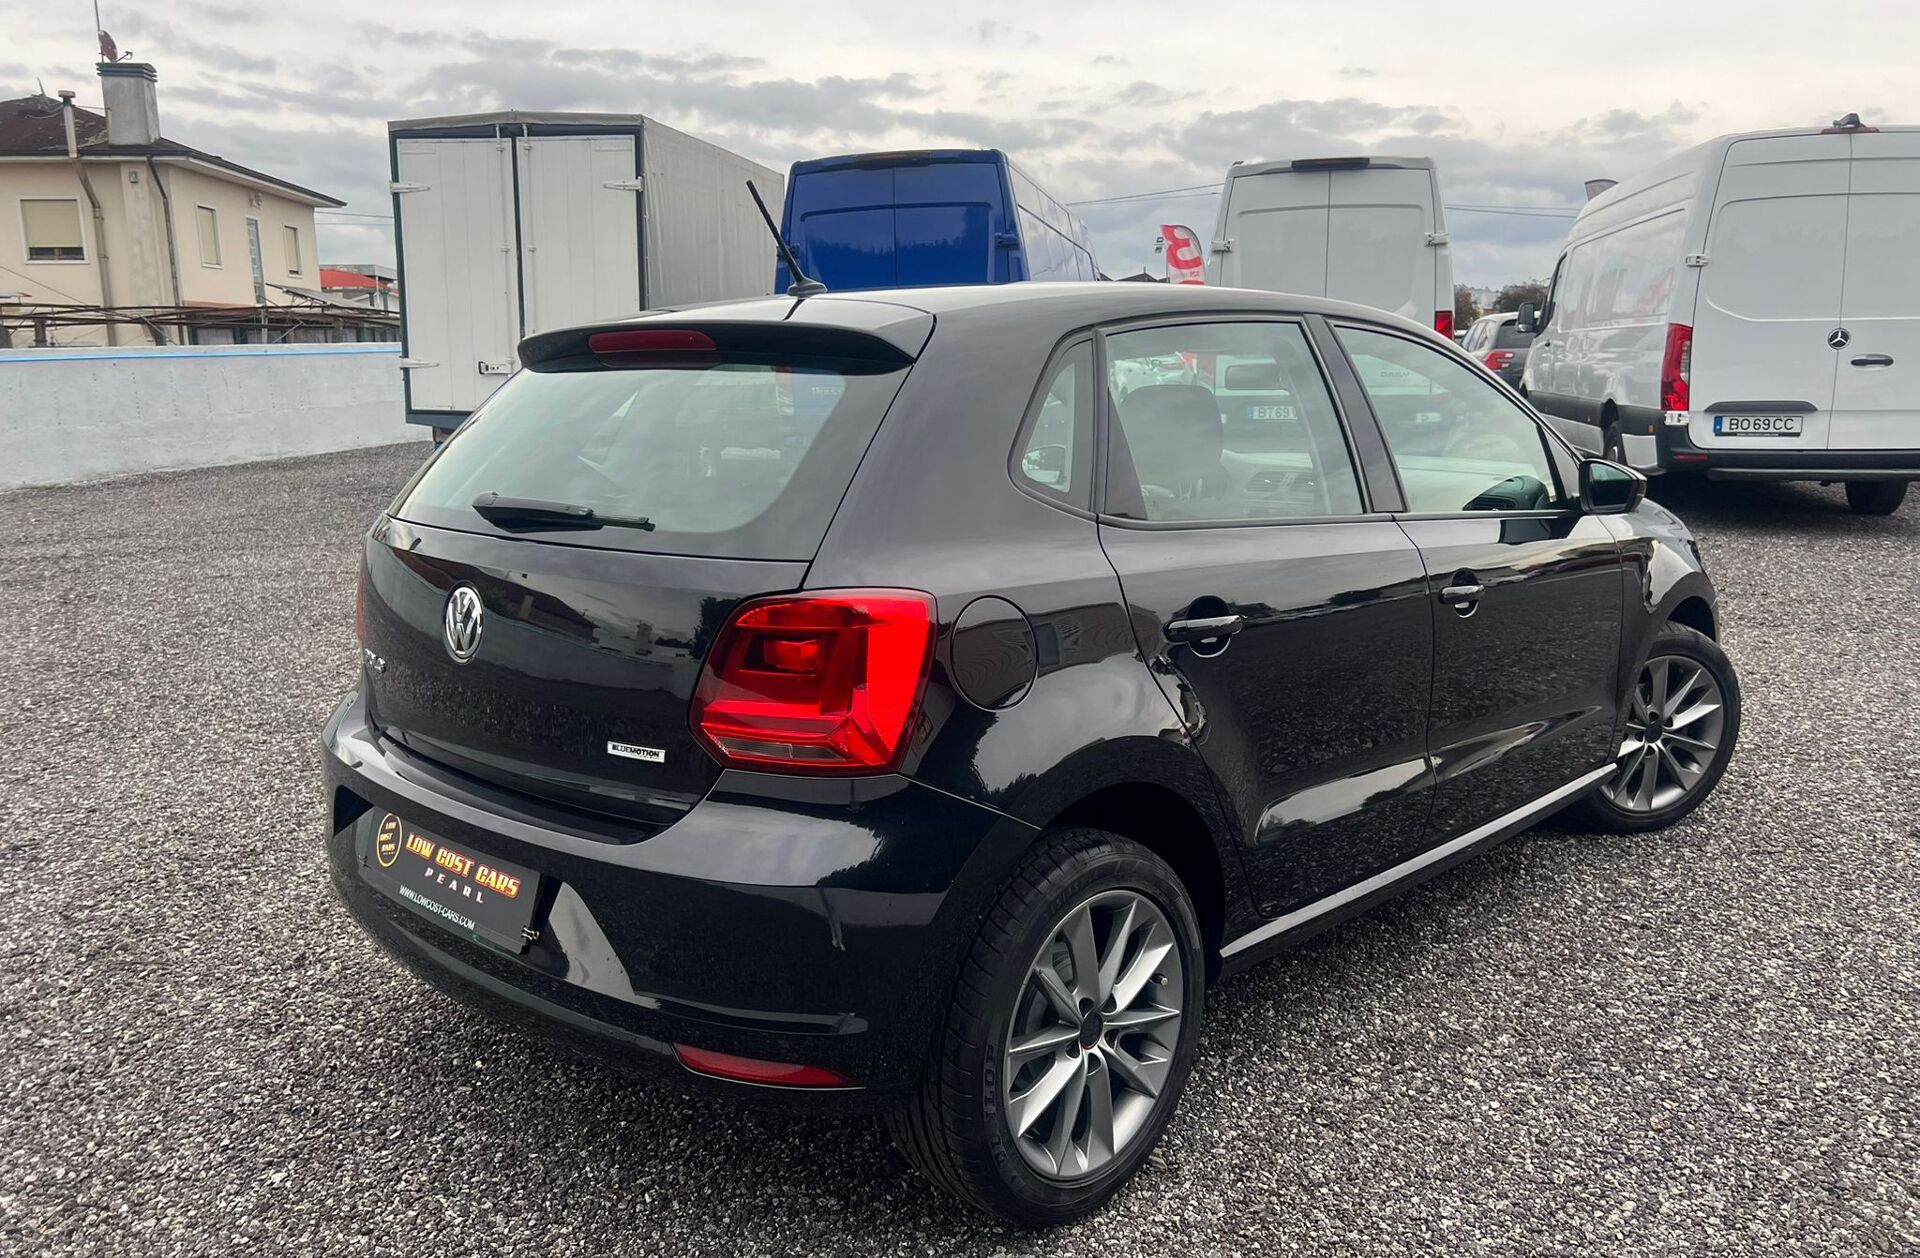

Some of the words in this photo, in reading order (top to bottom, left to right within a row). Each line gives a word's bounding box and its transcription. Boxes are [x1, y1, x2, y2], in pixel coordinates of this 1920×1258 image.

[611, 744, 660, 758] BLUEMOTION
[406, 832, 436, 860] LOW
[435, 847, 475, 878] COST
[474, 863, 521, 898] CARS
[424, 867, 484, 904] PEARL
[399, 884, 475, 930] WWW.LOWCOST-CARS.COM
